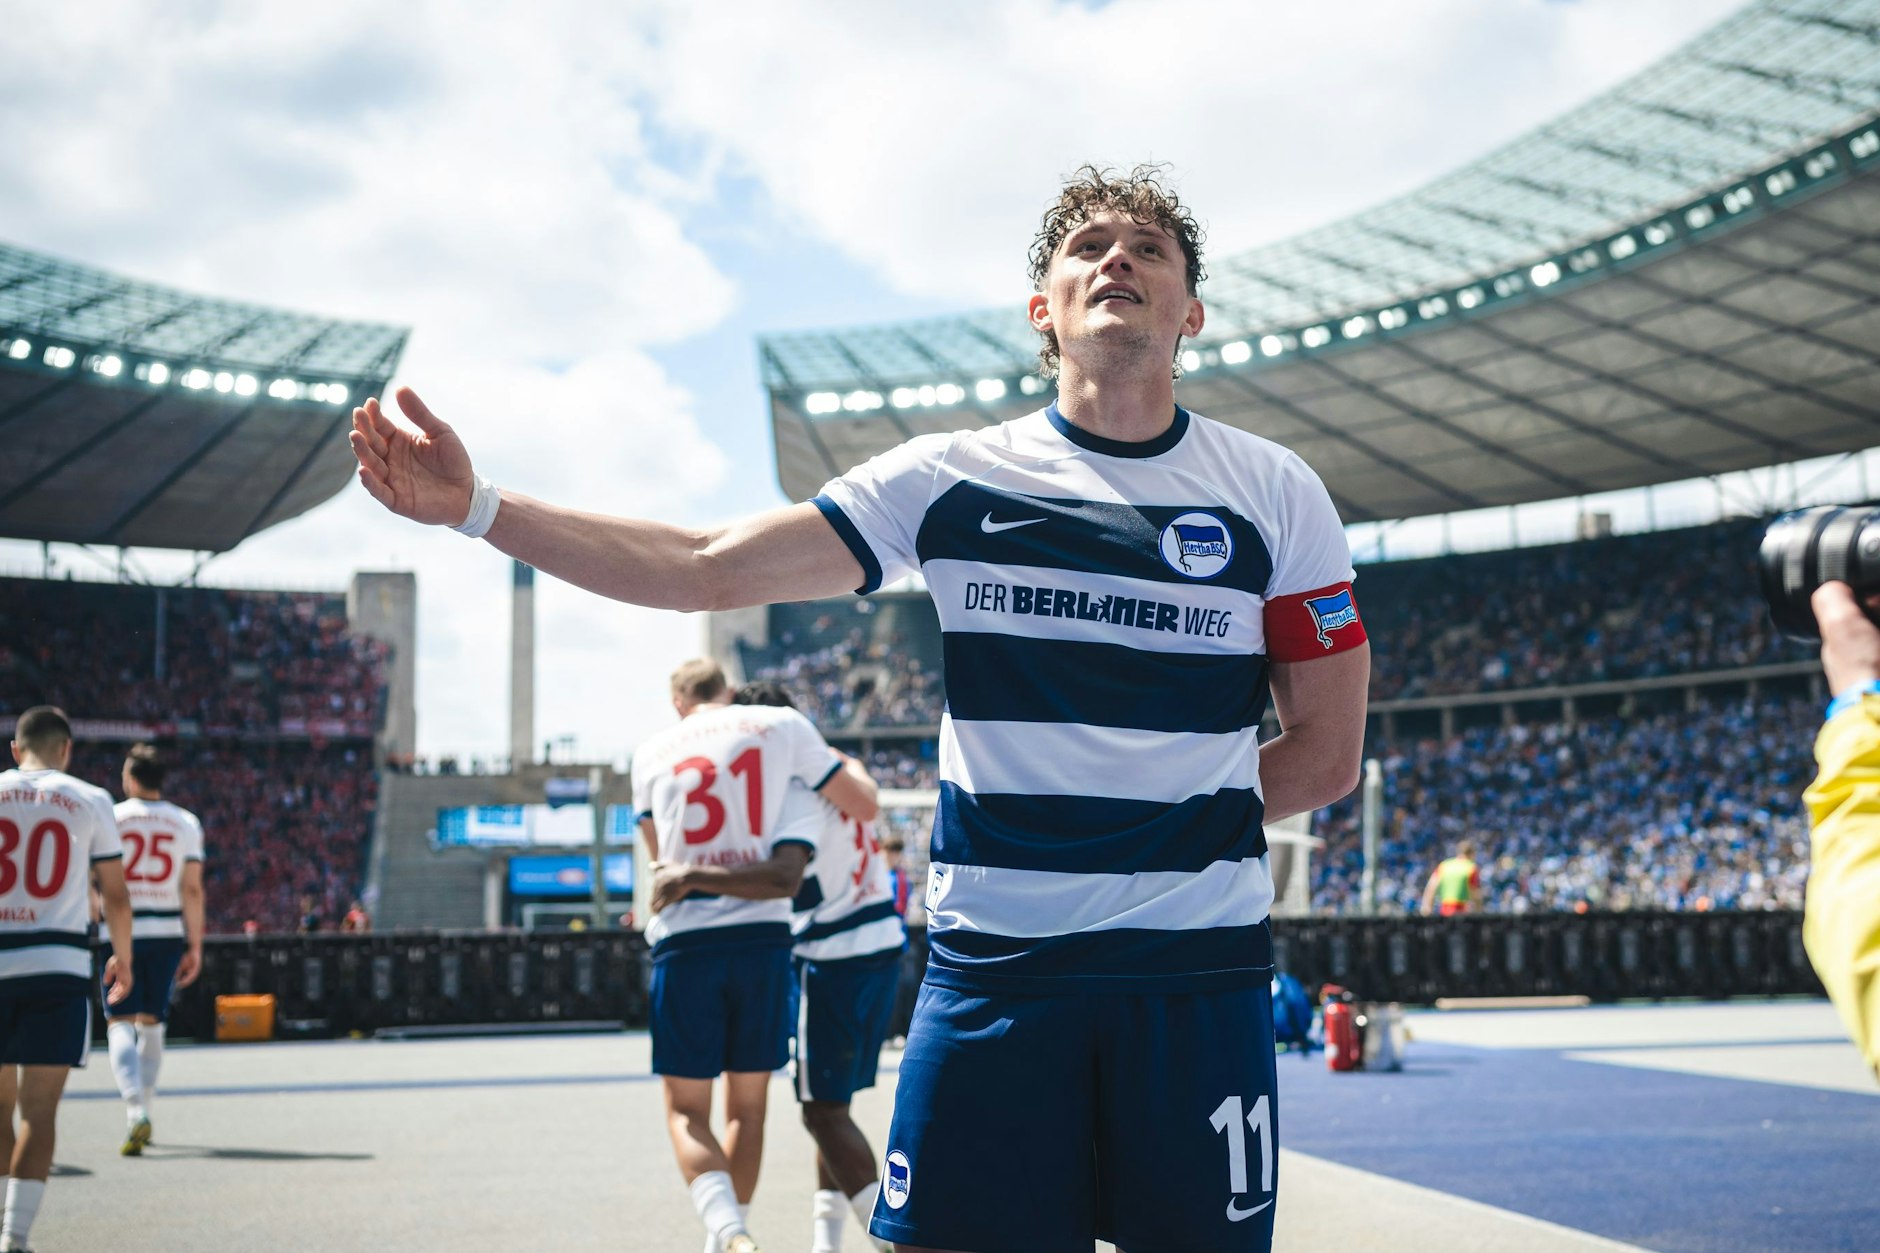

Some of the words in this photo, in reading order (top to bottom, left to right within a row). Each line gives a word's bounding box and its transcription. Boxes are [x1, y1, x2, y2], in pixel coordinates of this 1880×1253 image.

[1183, 541, 1210, 555] Hertha
[1210, 542, 1226, 555] BSC
[965, 582, 1006, 612] DER
[1012, 585, 1180, 633] BERLINER
[1184, 606, 1232, 637] WEG
[673, 747, 762, 846] 31
[121, 830, 175, 884] 25
[1208, 1095, 1273, 1193] 11
